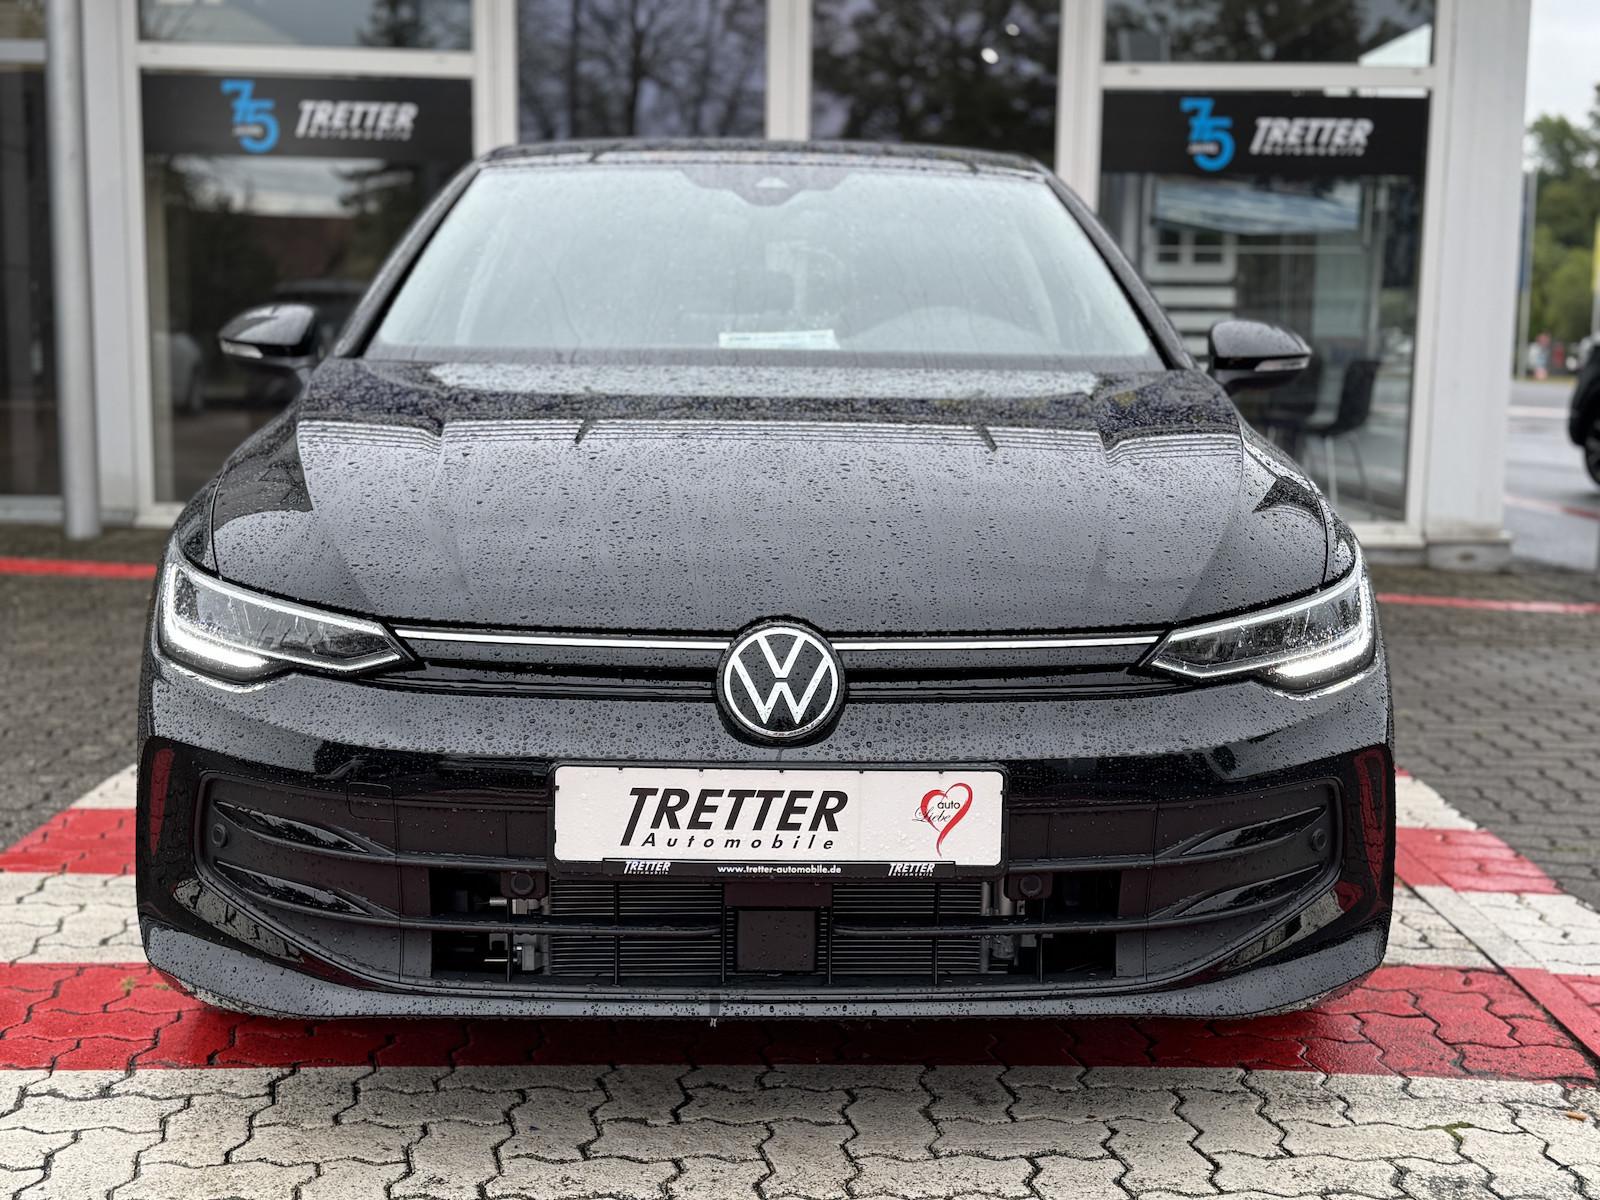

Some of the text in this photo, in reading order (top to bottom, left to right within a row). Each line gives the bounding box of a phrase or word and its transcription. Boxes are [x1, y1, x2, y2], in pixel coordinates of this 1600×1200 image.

[221, 80, 280, 153] 75
[296, 100, 418, 137] TRETTER
[1180, 97, 1235, 171] 75
[1250, 117, 1374, 154] TRETTER
[620, 787, 849, 846] TRETTER
[937, 800, 961, 809] auto
[641, 832, 834, 849] Automobile
[624, 861, 671, 874] TRETTER
[717, 864, 841, 874] www.tretter-automobile.de
[888, 863, 935, 876] TRETTER
